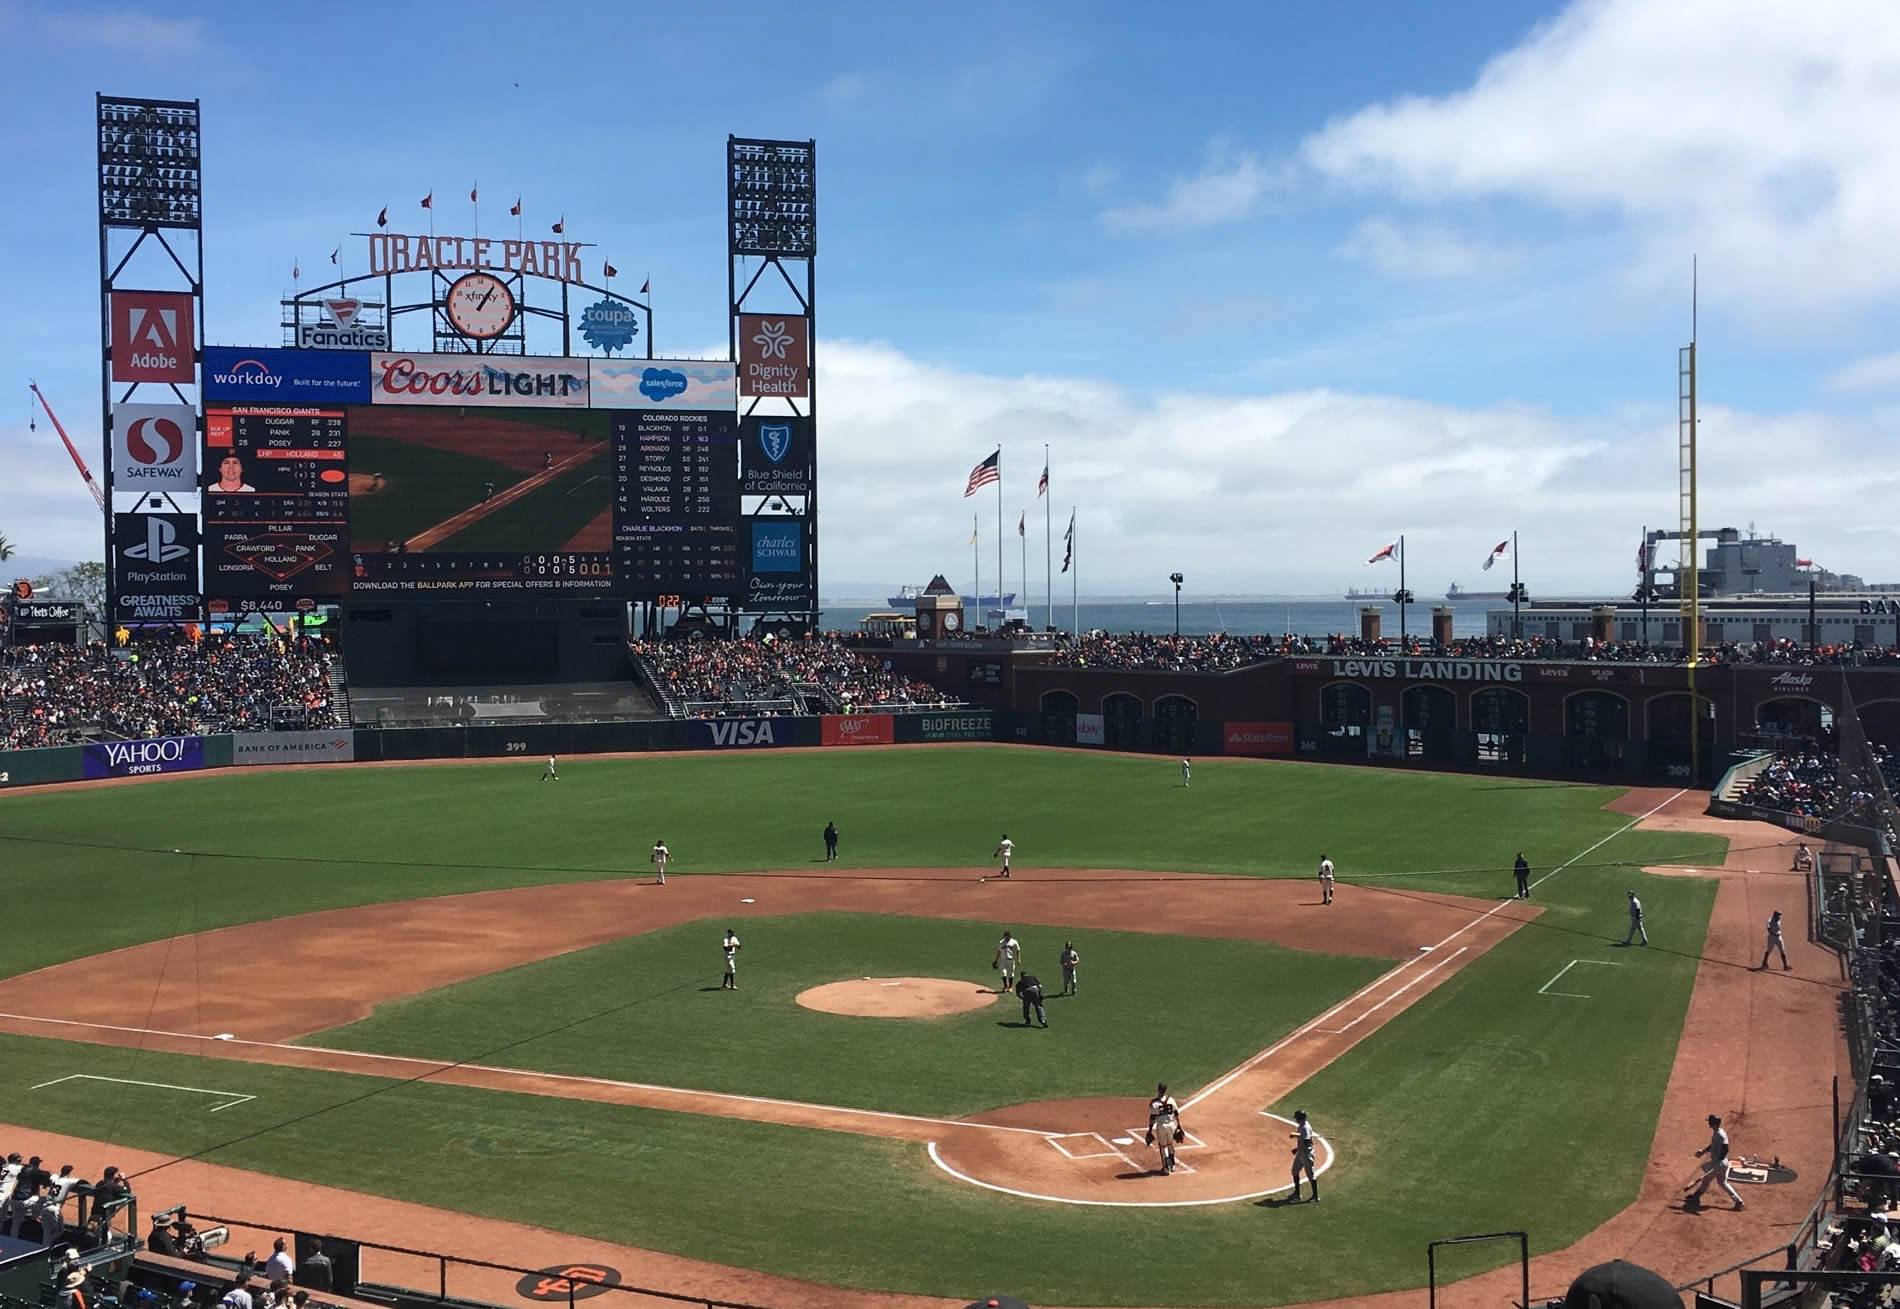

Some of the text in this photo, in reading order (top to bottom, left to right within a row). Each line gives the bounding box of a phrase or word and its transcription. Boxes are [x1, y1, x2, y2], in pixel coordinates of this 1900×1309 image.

[370, 234, 583, 285] ORACLE PARK
[588, 310, 632, 326] coupa
[302, 328, 385, 346] Fanatics
[131, 353, 176, 369] Adobe
[381, 359, 573, 396] Coors LIGHT
[750, 363, 799, 380] Dignity
[214, 372, 282, 387] workday
[646, 378, 683, 389] salesforce
[752, 380, 796, 393] Health
[127, 467, 183, 478] SAFEWAY
[748, 470, 802, 479] Blue Shield
[745, 481, 806, 490] of California
[757, 536, 794, 548] charles
[757, 549, 796, 557] SCHWAB
[128, 571, 186, 583] PlayStation
[120, 595, 194, 606] GREATNESS
[241, 600, 282, 612] $8,440
[134, 607, 182, 617] AWAITS
[1405, 662, 1522, 681] LANDING
[1771, 671, 1813, 685] Alaska
[704, 721, 774, 745] VISA
[1078, 721, 1100, 737] ebay
[104, 739, 185, 766] YAHOO!
[283, 743, 326, 751] AMERICA
[506, 742, 526, 751] 399
[129, 764, 161, 774] SPORTS
